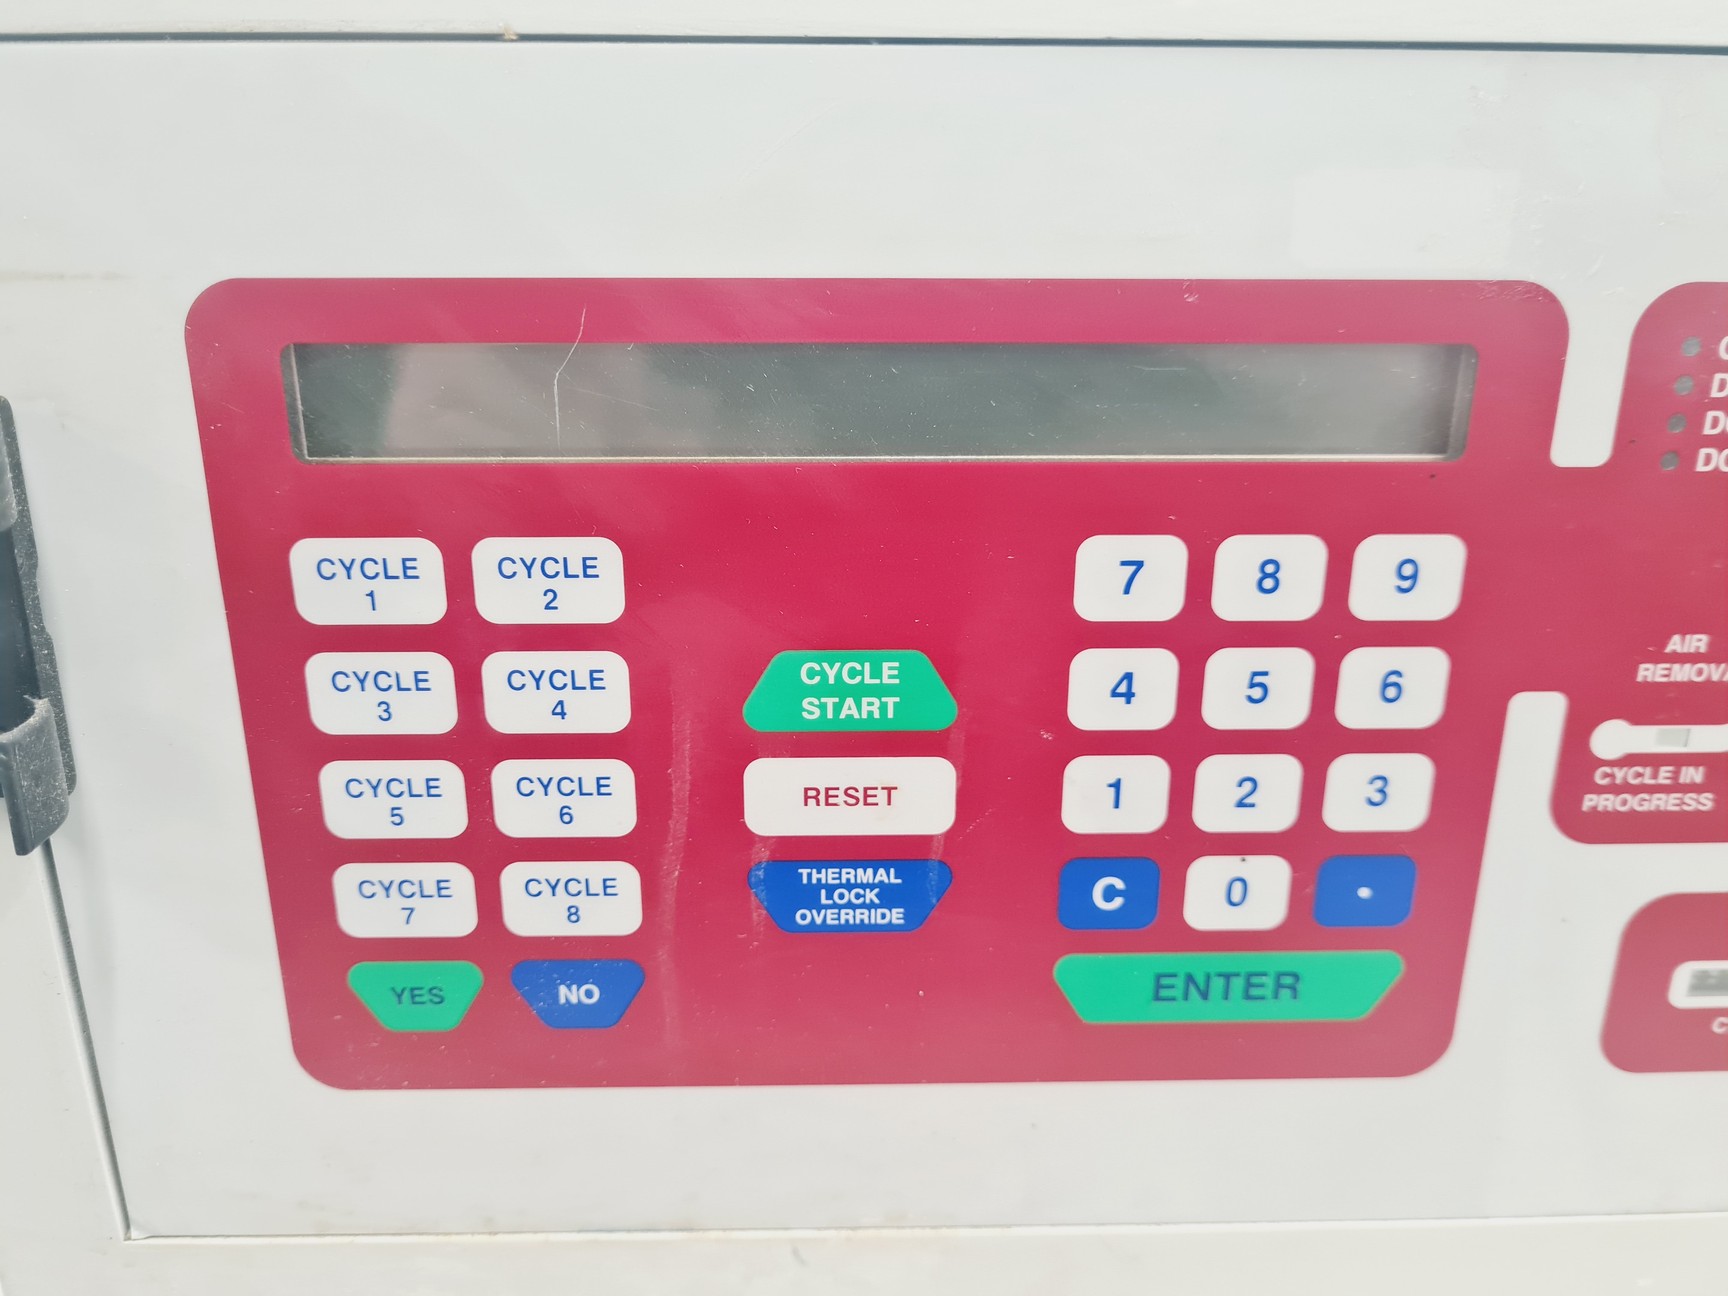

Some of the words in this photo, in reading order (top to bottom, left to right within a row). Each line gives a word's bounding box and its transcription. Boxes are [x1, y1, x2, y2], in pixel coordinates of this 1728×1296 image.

[316, 558, 420, 580] CYCLE
[498, 556, 600, 579] CYCLE
[1118, 560, 1145, 595] 7
[1256, 559, 1281, 594] 8
[1394, 558, 1419, 594] 9
[365, 590, 377, 611] 1
[543, 588, 558, 610] 2
[1664, 634, 1710, 653] AIR
[331, 671, 432, 692] CYCLE
[507, 669, 606, 691] CYCLE
[800, 662, 900, 684] CYCLE
[1110, 671, 1136, 705] 4
[1245, 670, 1270, 704] 5
[1379, 670, 1404, 704] 6
[377, 701, 392, 721] 3
[551, 700, 567, 720] 4
[801, 697, 900, 719] START
[1594, 766, 1674, 785] CYCLE
[1679, 766, 1705, 784] IN
[345, 778, 442, 798] CYCLE
[516, 777, 612, 797] CYCLE
[803, 786, 898, 807] RESET
[1106, 777, 1124, 809] 1
[1234, 776, 1259, 808] 2
[1365, 774, 1390, 807] 3
[1581, 793, 1715, 812] PROGRESS
[390, 807, 405, 826] 5
[559, 806, 574, 825] 6
[798, 868, 902, 884] THERMAL
[358, 879, 453, 898] CYCLE
[524, 878, 618, 897] CYCLE
[820, 888, 880, 904] LOCK
[1092, 876, 1127, 911] C
[401, 907, 416, 925] 7
[566, 905, 581, 924] 8
[795, 908, 905, 925] OVERRIDE
[392, 986, 445, 1005] YES
[558, 984, 600, 1005] NO
[1151, 971, 1301, 1003] ENTER
